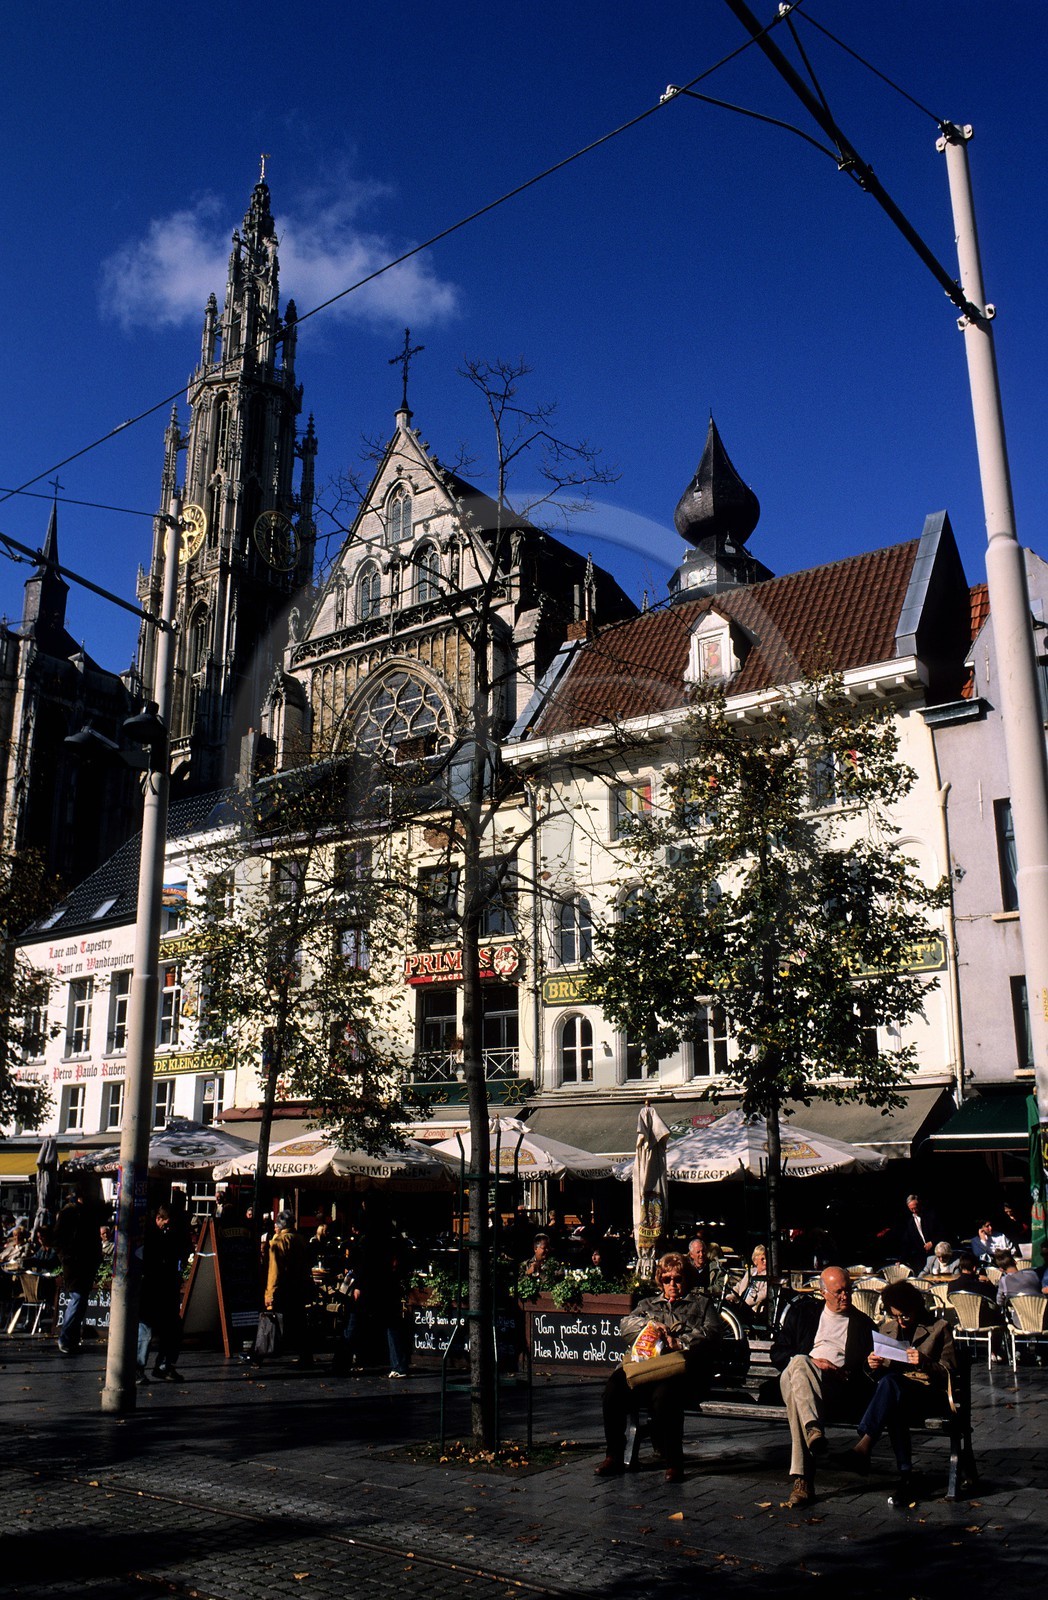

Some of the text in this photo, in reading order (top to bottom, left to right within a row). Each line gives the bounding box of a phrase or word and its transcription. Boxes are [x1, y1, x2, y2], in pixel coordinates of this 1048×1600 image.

[49, 939, 113, 959] Lace and Tapestry
[405, 947, 492, 975] PRIMS
[75, 1064, 98, 1082] Paulo
[157, 1159, 195, 1168] Charles
[414, 1310, 436, 1330] Zelfs
[535, 1314, 555, 1334] Van
[560, 1318, 598, 1340] pasta's
[534, 1340, 553, 1358] Hier
[553, 1340, 579, 1360] koken
[582, 1340, 607, 1362] enkel
